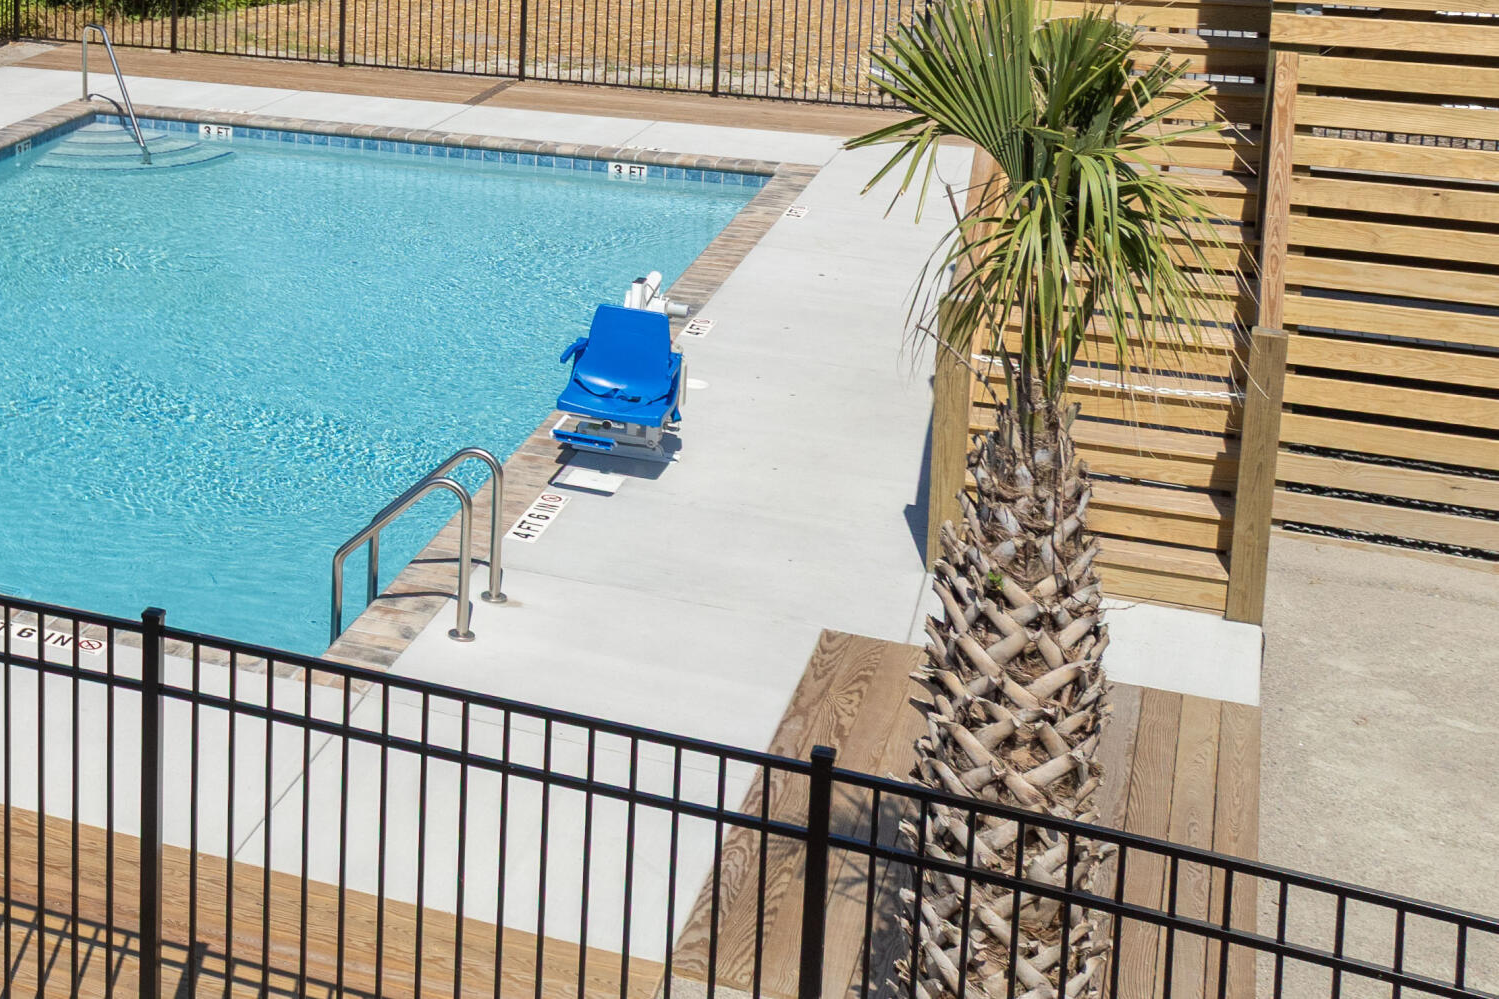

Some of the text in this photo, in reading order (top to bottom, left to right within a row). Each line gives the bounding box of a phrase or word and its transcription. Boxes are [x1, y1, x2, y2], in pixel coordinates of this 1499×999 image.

[517, 520, 544, 532] FT
[533, 502, 559, 513] IN
[17, 627, 37, 638] 6
[43, 632, 74, 647] IN
